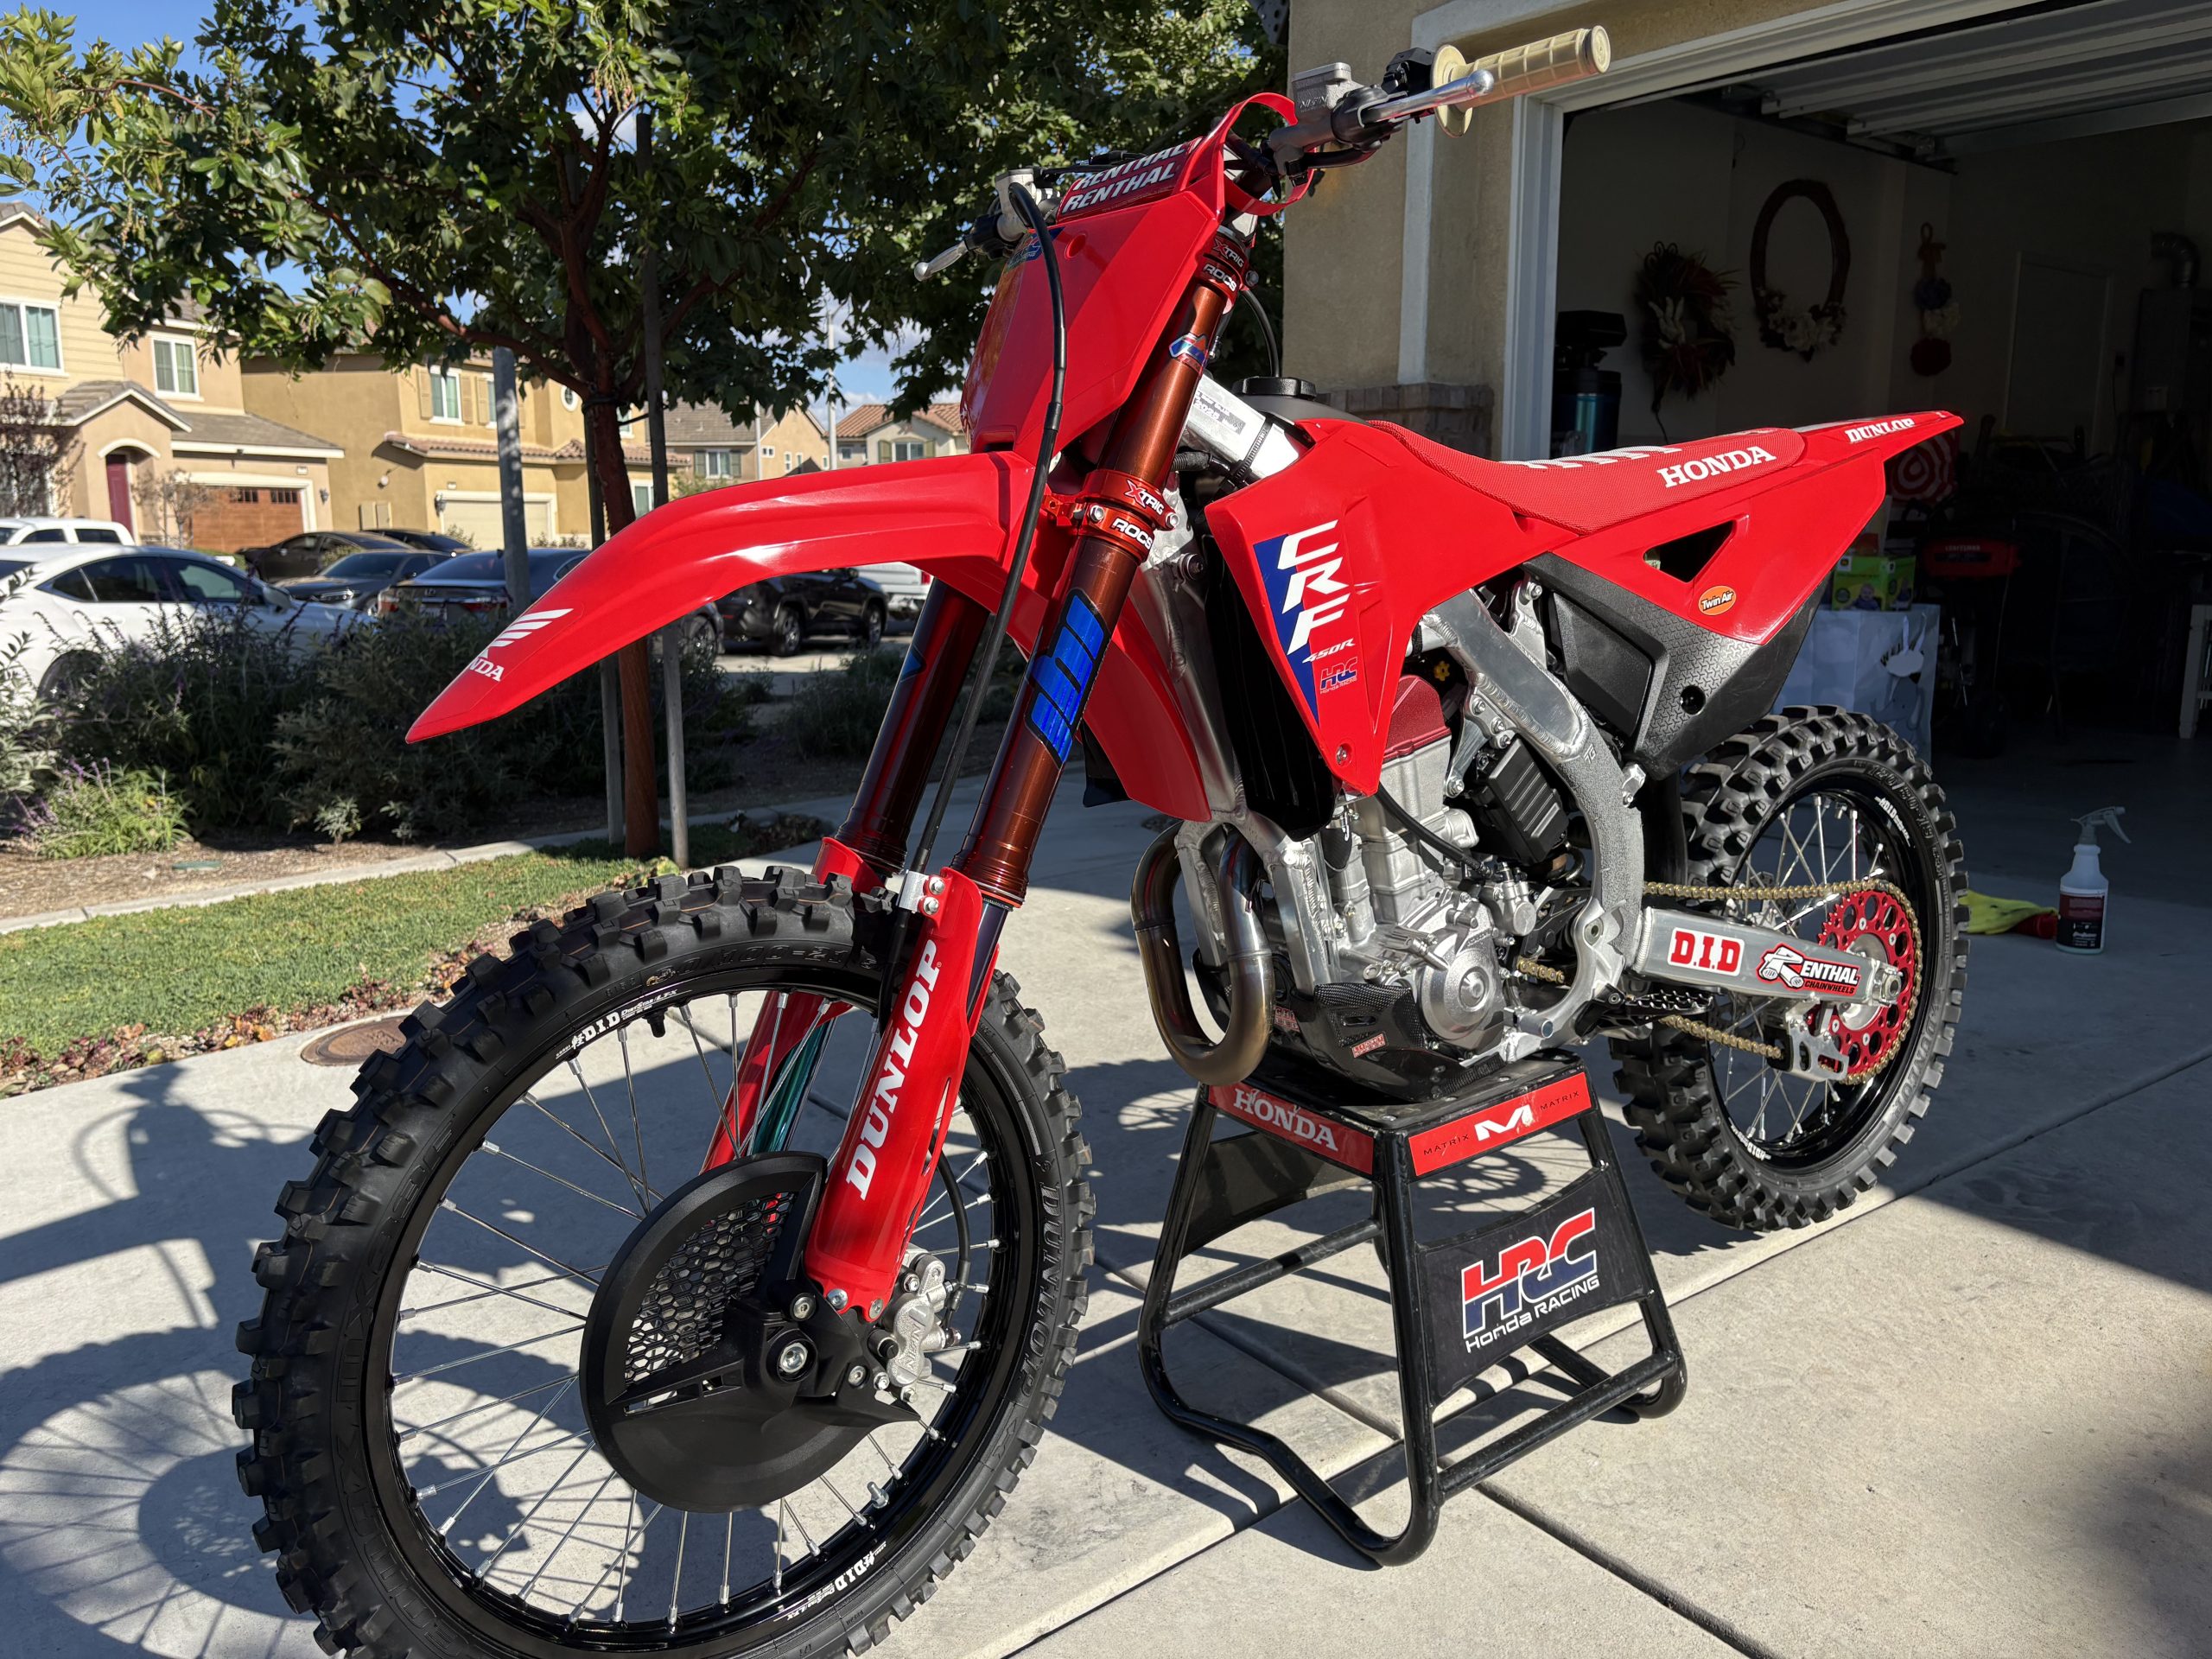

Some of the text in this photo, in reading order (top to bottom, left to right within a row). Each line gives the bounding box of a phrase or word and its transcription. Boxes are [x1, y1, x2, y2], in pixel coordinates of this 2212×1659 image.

[1062, 162, 1176, 214] RENTHAL
[1214, 238, 1244, 269] XTRIG
[1203, 264, 1237, 292] ROCS
[1845, 418, 1916, 443] DUNLOP
[1656, 446, 1777, 487] HONDA
[1124, 479, 1165, 516] XTRIG
[1111, 518, 1154, 550] ROCS
[1277, 519, 1351, 655] CRF
[1701, 590, 1734, 611] Twin Air
[1302, 638, 1355, 664] 450R
[469, 656, 505, 682] NDA
[1320, 657, 1358, 690] HRC
[1670, 931, 1741, 973] D.I.D
[1804, 980, 1855, 995] CHAINWHEELS
[582, 1012, 620, 1039] D.I.D
[846, 939, 938, 1200] DUNLOP
[1541, 1090, 1580, 1111] MATRIX
[1233, 1088, 1338, 1152] HONDA
[1423, 1134, 1470, 1155] MATRIX
[1461, 1207, 1597, 1339] HRC
[1020, 1182, 1063, 1397] DUNLOP
[1465, 1274, 1600, 1353] Honda RACING
[835, 1559, 868, 1591] D.I.D
